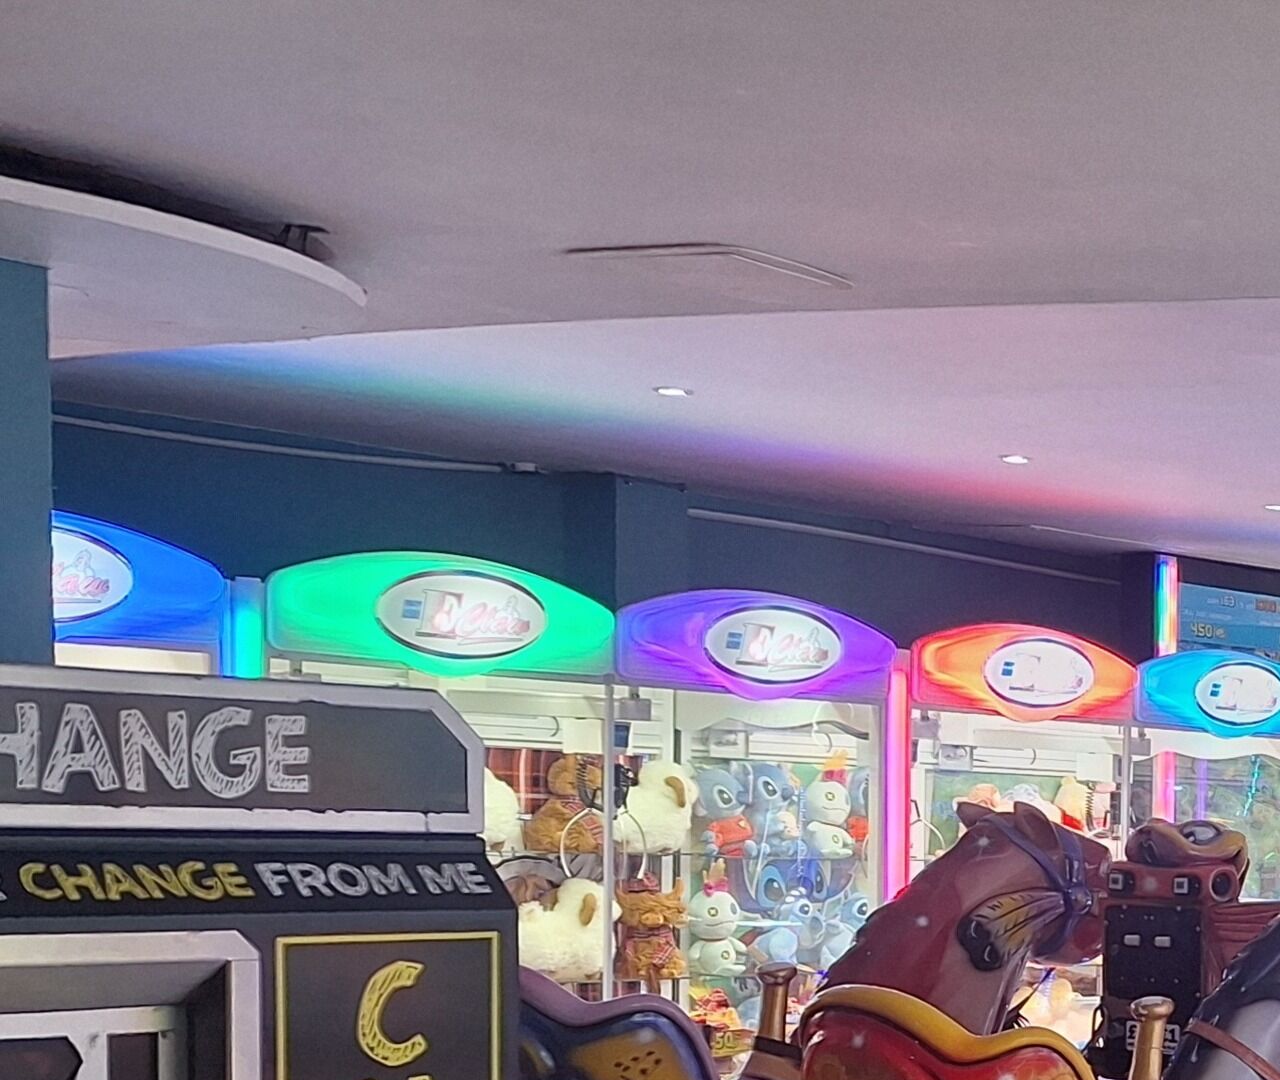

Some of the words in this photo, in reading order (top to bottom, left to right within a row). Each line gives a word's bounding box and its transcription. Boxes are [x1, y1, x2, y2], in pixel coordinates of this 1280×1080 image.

[18, 861, 256, 900] CHANGE
[255, 861, 418, 897] FROM
[416, 862, 493, 896] ME
